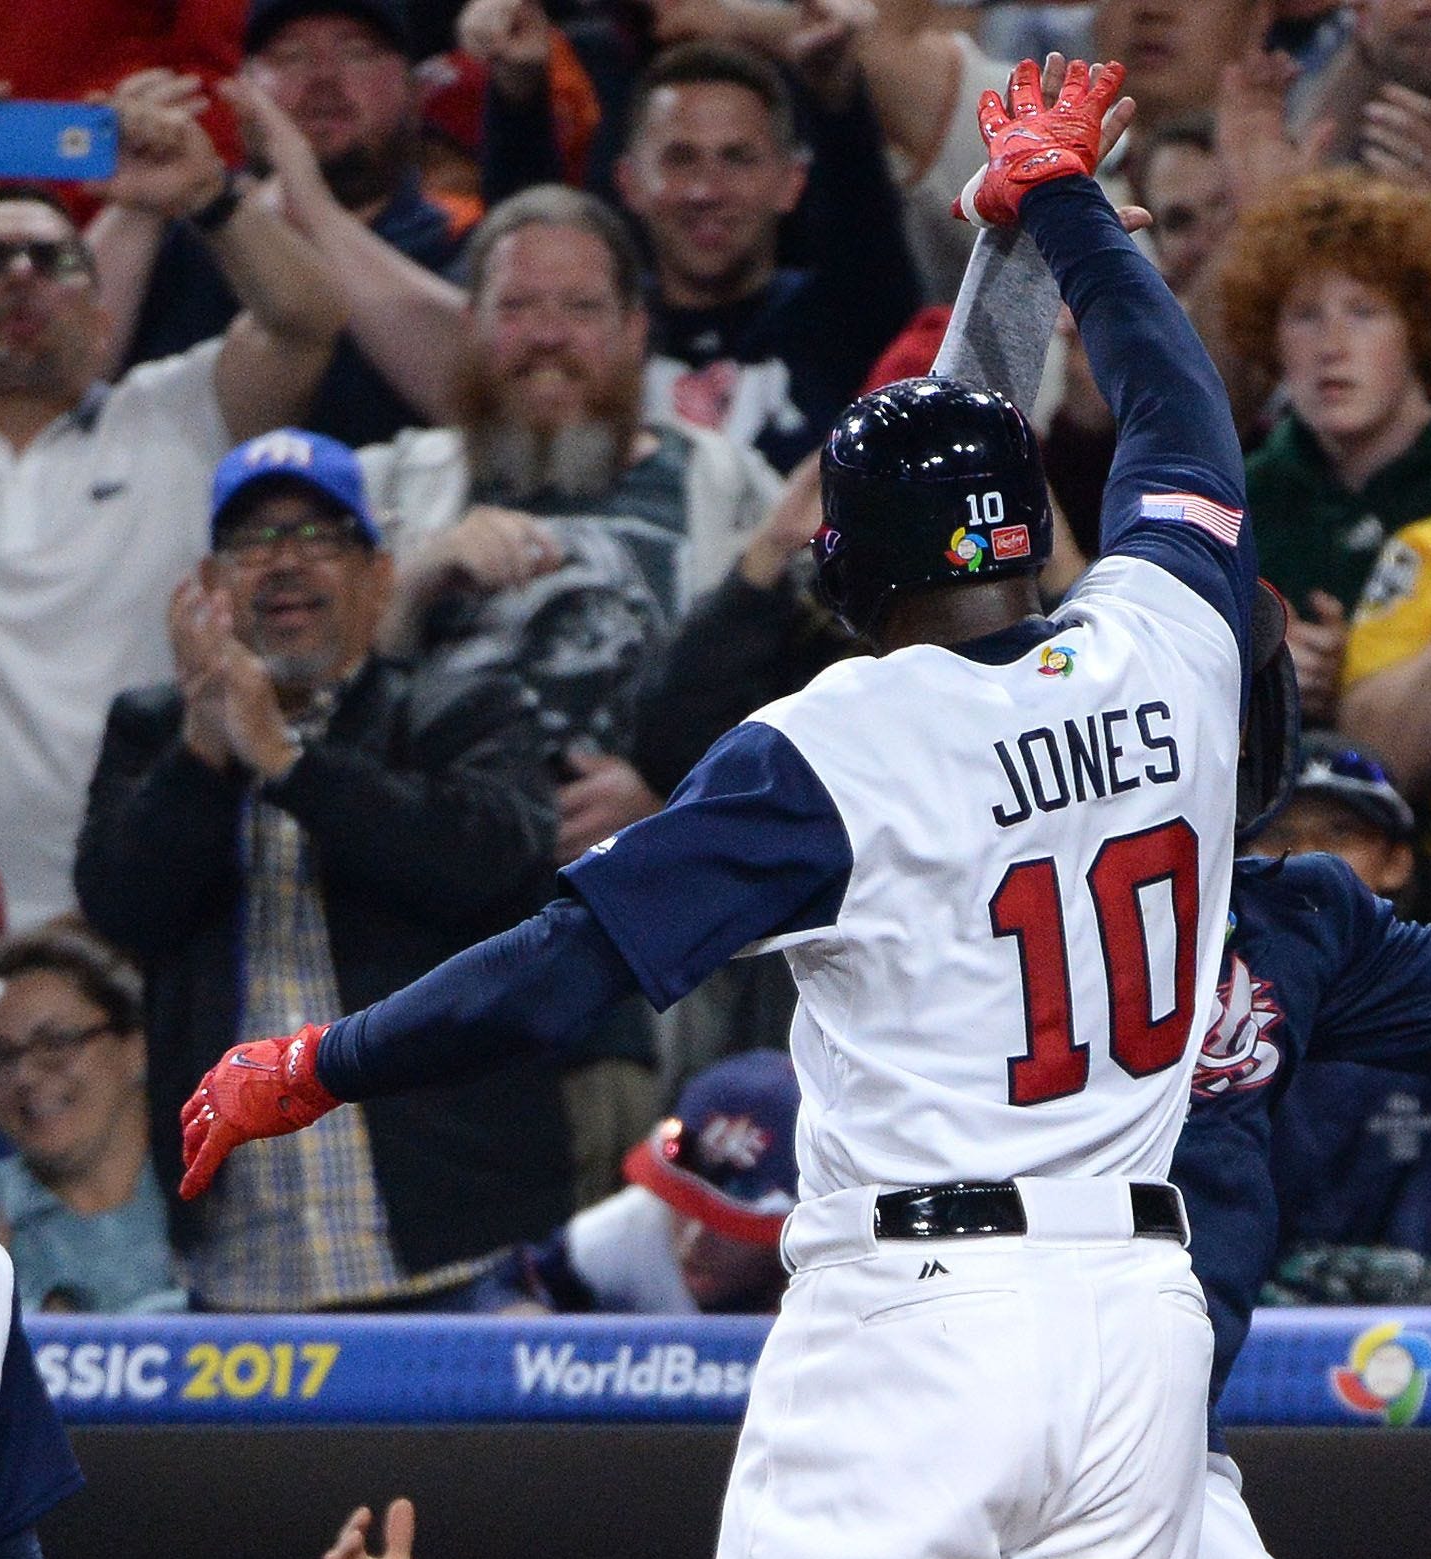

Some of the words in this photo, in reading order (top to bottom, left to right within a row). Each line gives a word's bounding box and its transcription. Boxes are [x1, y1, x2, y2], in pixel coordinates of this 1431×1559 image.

[965, 490, 1004, 527] 10
[991, 700, 1181, 828] JONES
[987, 814, 1200, 1107] 10
[181, 1343, 342, 1400] 2017
[514, 1343, 760, 1397] WorldBas
